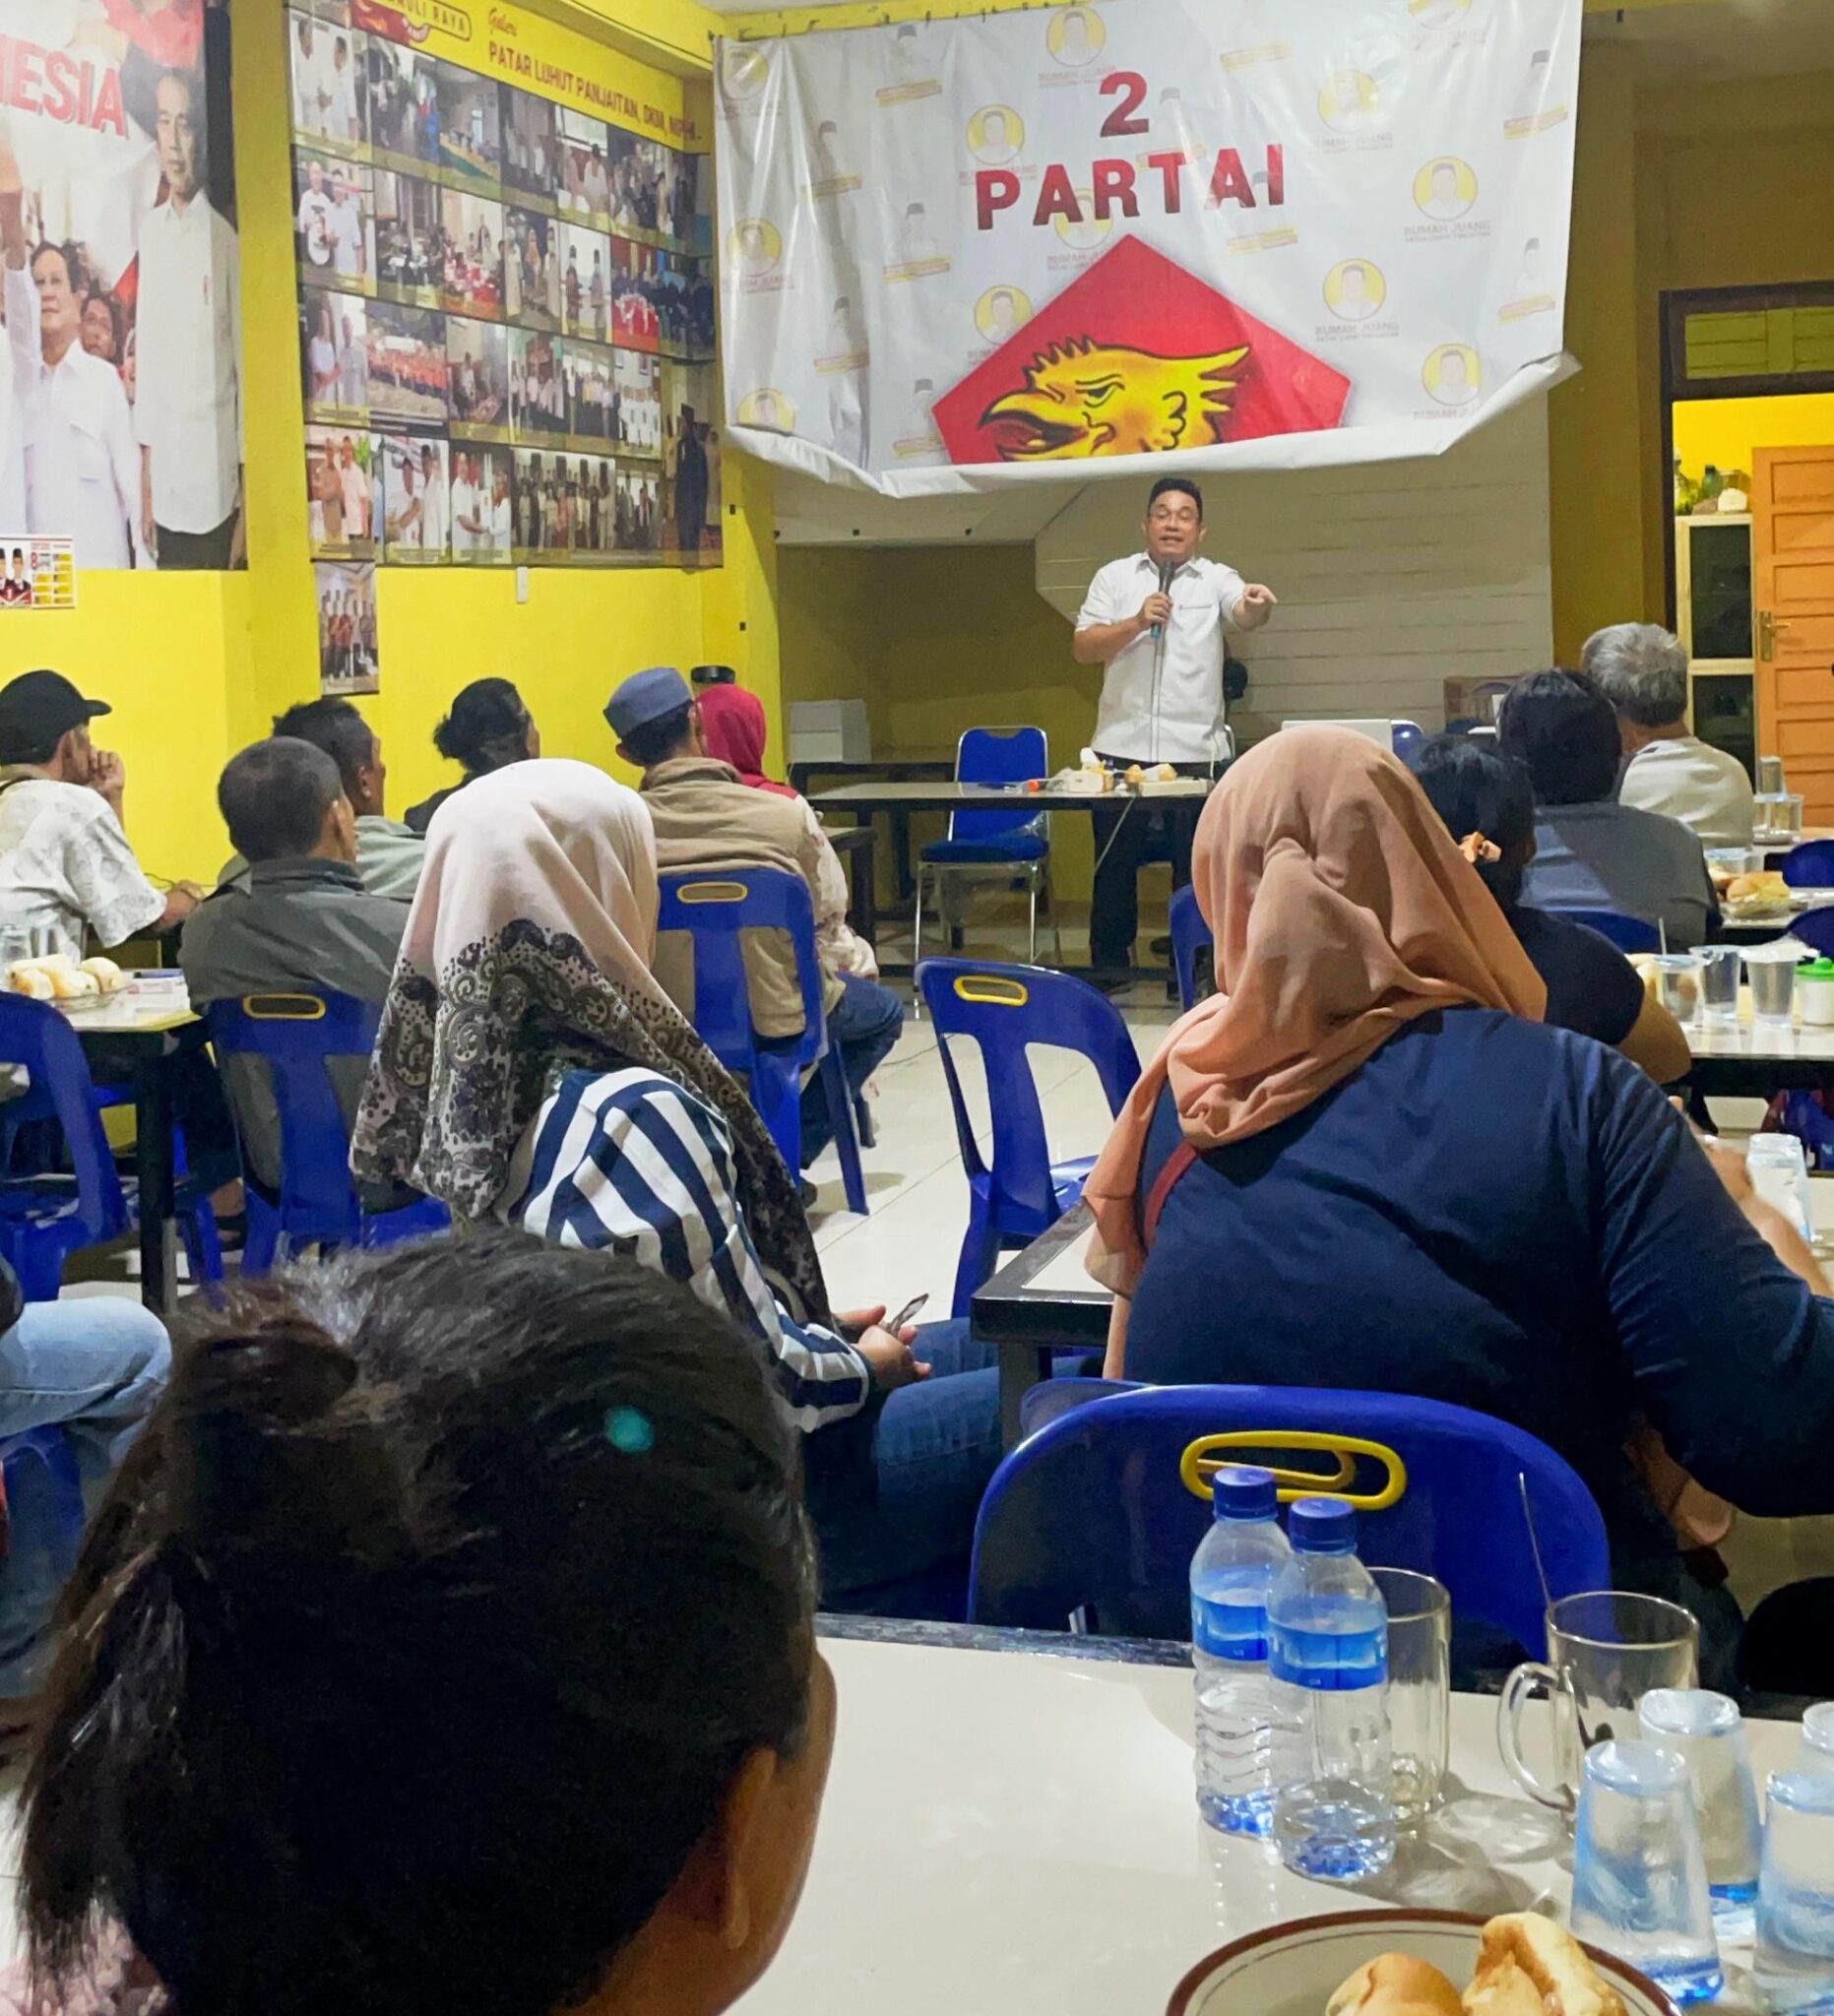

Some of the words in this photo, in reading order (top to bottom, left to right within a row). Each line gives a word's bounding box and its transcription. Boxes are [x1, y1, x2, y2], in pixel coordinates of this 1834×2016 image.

[488, 40, 532, 78] PATAR
[535, 59, 574, 94] LUHUT
[1099, 71, 1150, 138] 2
[975, 144, 1285, 230] PARTAI
